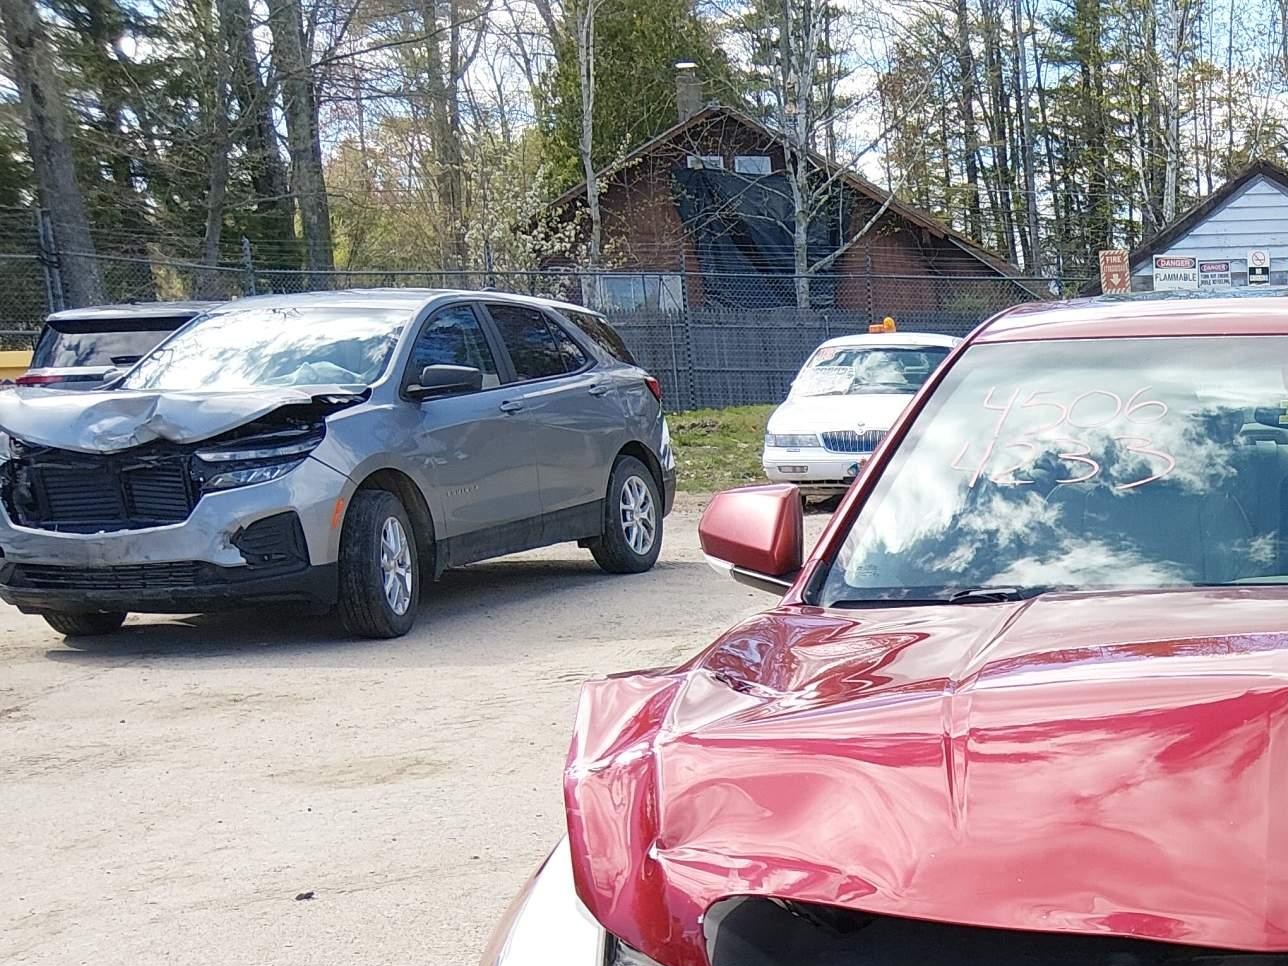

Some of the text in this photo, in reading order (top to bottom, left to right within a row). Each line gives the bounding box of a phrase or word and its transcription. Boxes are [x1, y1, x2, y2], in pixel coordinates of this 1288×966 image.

[1105, 255, 1122, 264] FIRE
[1202, 264, 1226, 272] DANGER
[1155, 272, 1197, 282] FLAMMABLE
[983, 386, 1168, 437] 4506
[951, 433, 1176, 490] 4233
